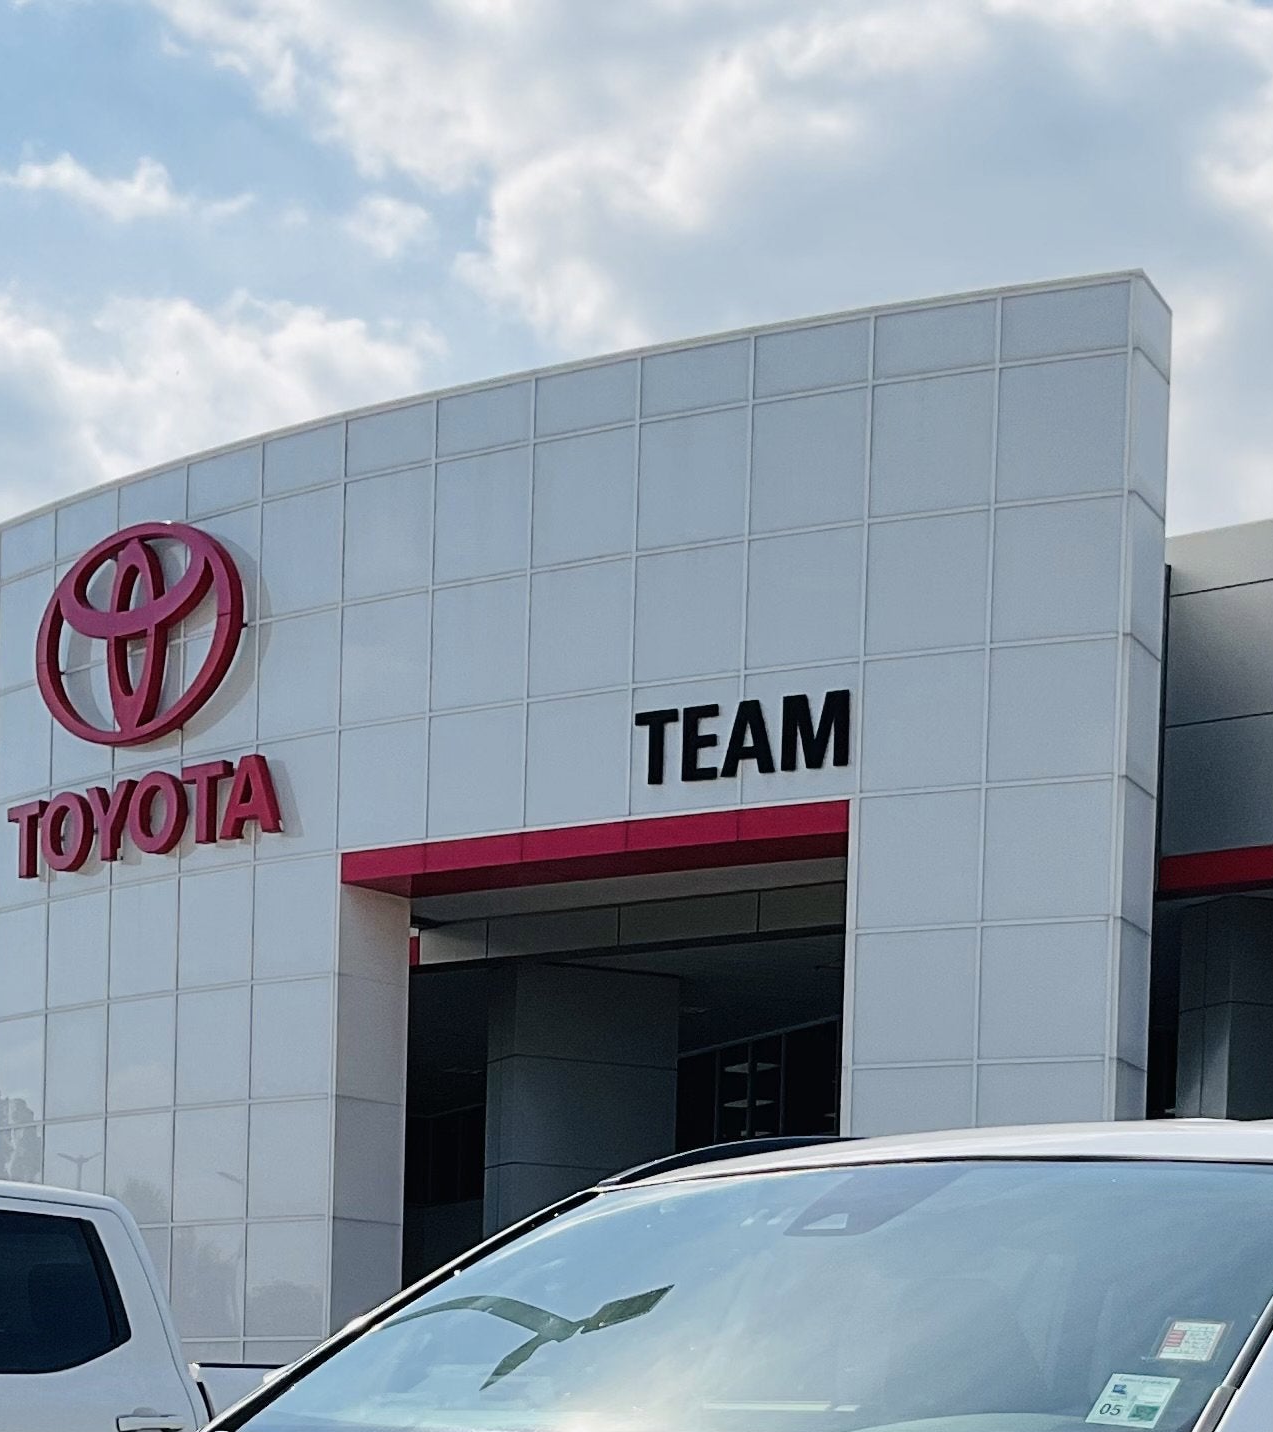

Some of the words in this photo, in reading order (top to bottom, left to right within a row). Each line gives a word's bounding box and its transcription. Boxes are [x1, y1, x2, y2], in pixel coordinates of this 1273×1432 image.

[634, 689, 851, 785] TEAM
[7, 753, 284, 880] TOYOTA
[1099, 1403, 1122, 1416] 05
